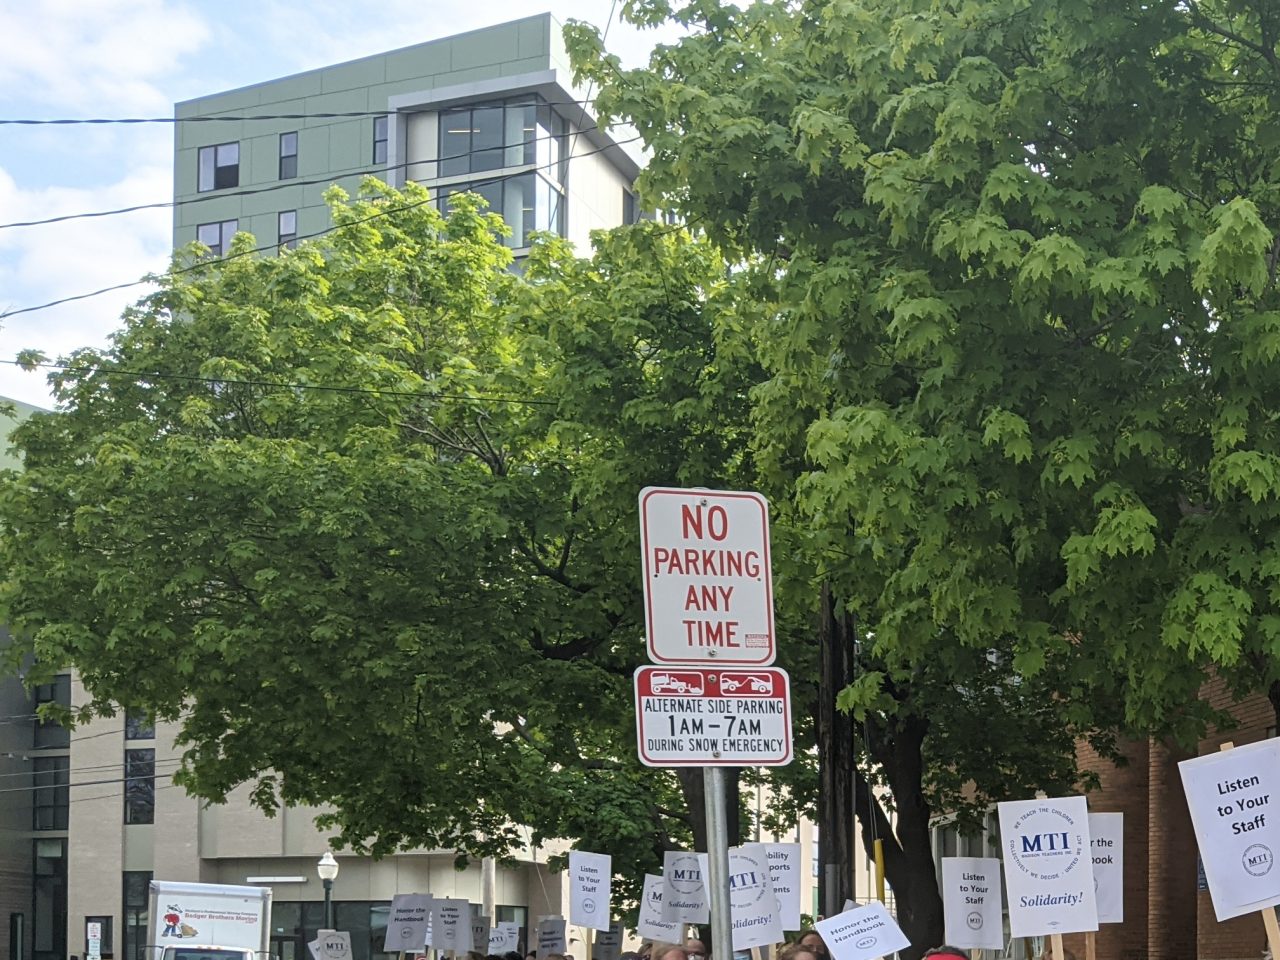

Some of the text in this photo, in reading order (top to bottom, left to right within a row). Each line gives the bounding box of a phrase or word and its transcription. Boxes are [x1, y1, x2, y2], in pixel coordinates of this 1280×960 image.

[682, 504, 728, 541] NO
[654, 547, 760, 578] PARKING
[684, 584, 734, 612] ANY
[682, 620, 741, 648] TIME
[645, 698, 783, 714] ALTERNATE SIDE PARKING
[648, 738, 783, 752] DURING SNOW EMERGENCY
[1217, 775, 1260, 795] Listen
[1217, 793, 1270, 817] to Your
[1232, 813, 1266, 835] Staff
[1020, 832, 1070, 853] MTI
[1097, 837, 1113, 848] the
[767, 852, 789, 861] bility
[1248, 853, 1267, 865] MTI
[580, 866, 598, 874] Listen
[674, 869, 701, 880] MTI
[769, 864, 790, 872] ports
[586, 876, 600, 884] Your
[962, 872, 985, 882] Listen
[971, 885, 989, 893] Your
[668, 901, 703, 909] Solidarity!
[965, 896, 984, 904] Staff
[1020, 891, 1084, 908] Solidarity!
[645, 919, 677, 930] Solidarity!
[732, 913, 772, 930] olidarity!
[830, 914, 880, 936] Honor the
[834, 921, 886, 944] Handbook
